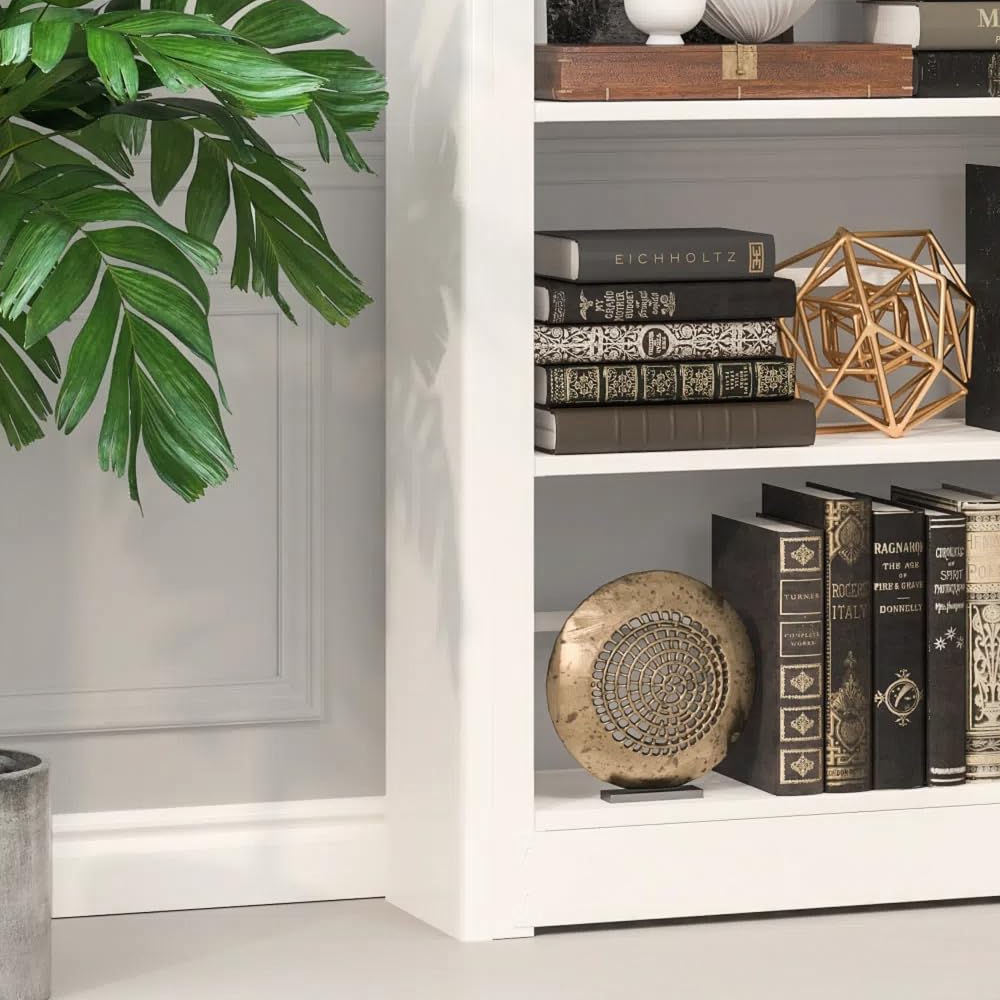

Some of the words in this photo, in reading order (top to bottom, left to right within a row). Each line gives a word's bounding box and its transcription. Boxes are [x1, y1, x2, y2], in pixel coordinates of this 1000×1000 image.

[615, 252, 737, 265] EICHHOLTZ
[595, 299, 604, 312] MY
[604, 290, 615, 319] GRAND
[882, 562, 901, 570] THE
[832, 604, 867, 620] ITALY
[880, 604, 922, 614] DONNELLY
